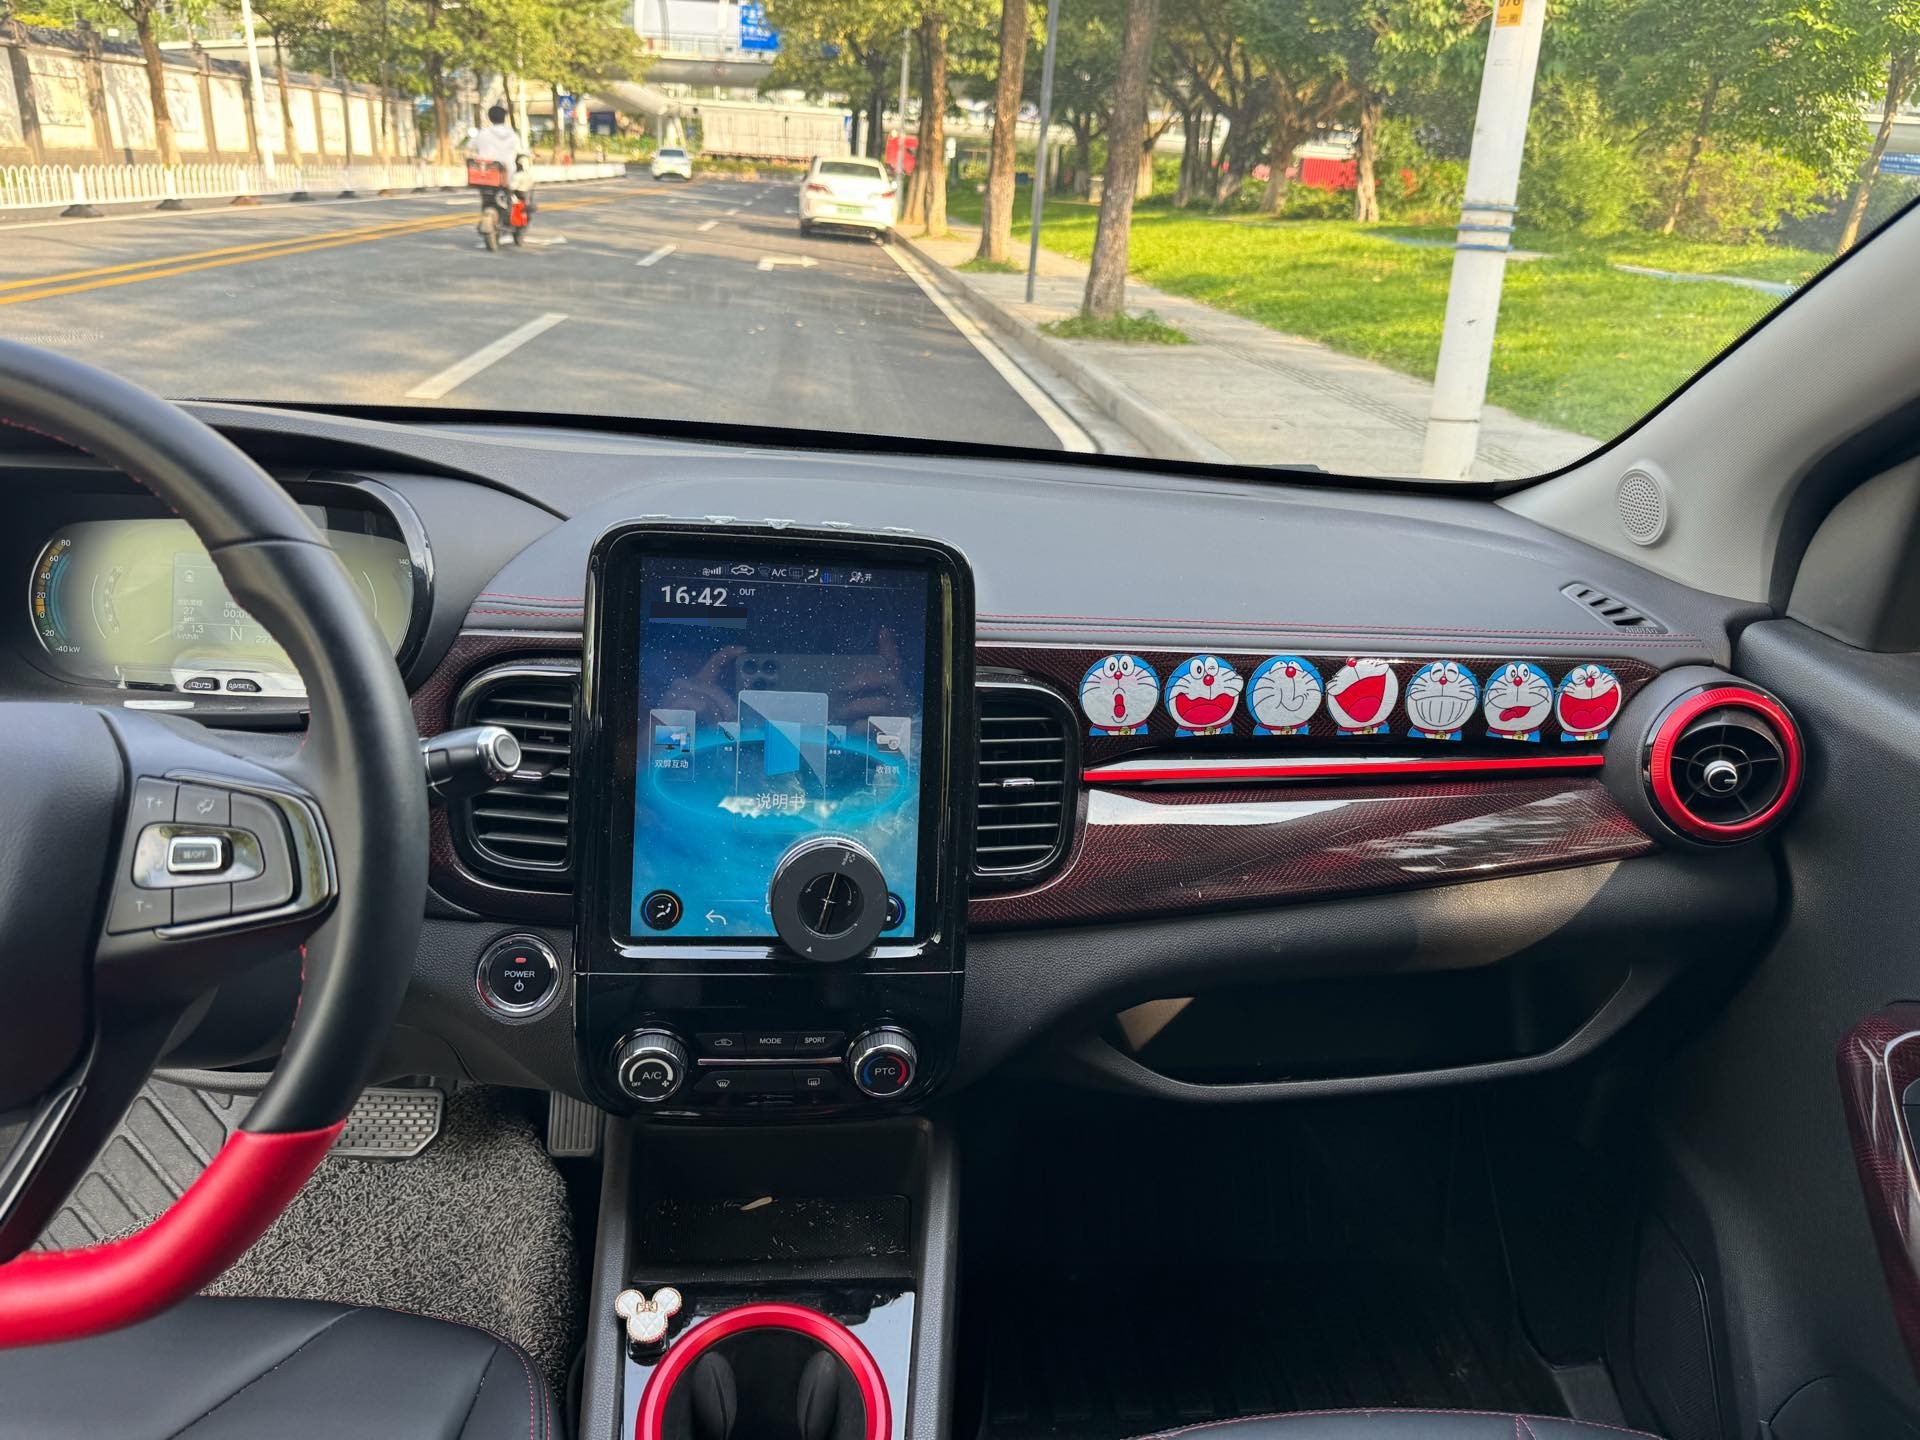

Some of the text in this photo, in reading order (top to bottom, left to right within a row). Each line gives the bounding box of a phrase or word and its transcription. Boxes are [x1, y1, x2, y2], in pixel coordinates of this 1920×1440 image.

[771, 568, 787, 577] A/C
[661, 585, 728, 607] 16:42
[739, 587, 756, 596] OUT
[42, 629, 55, 637] -20
[230, 626, 242, 641] N
[55, 645, 81, 653] -40 kW
[755, 792, 806, 811] 说明书
[504, 970, 536, 978] POWER
[759, 1037, 783, 1046] MODE
[804, 1036, 826, 1045] SPORT
[642, 1071, 662, 1080] A/C
[874, 1067, 896, 1077] PTC
